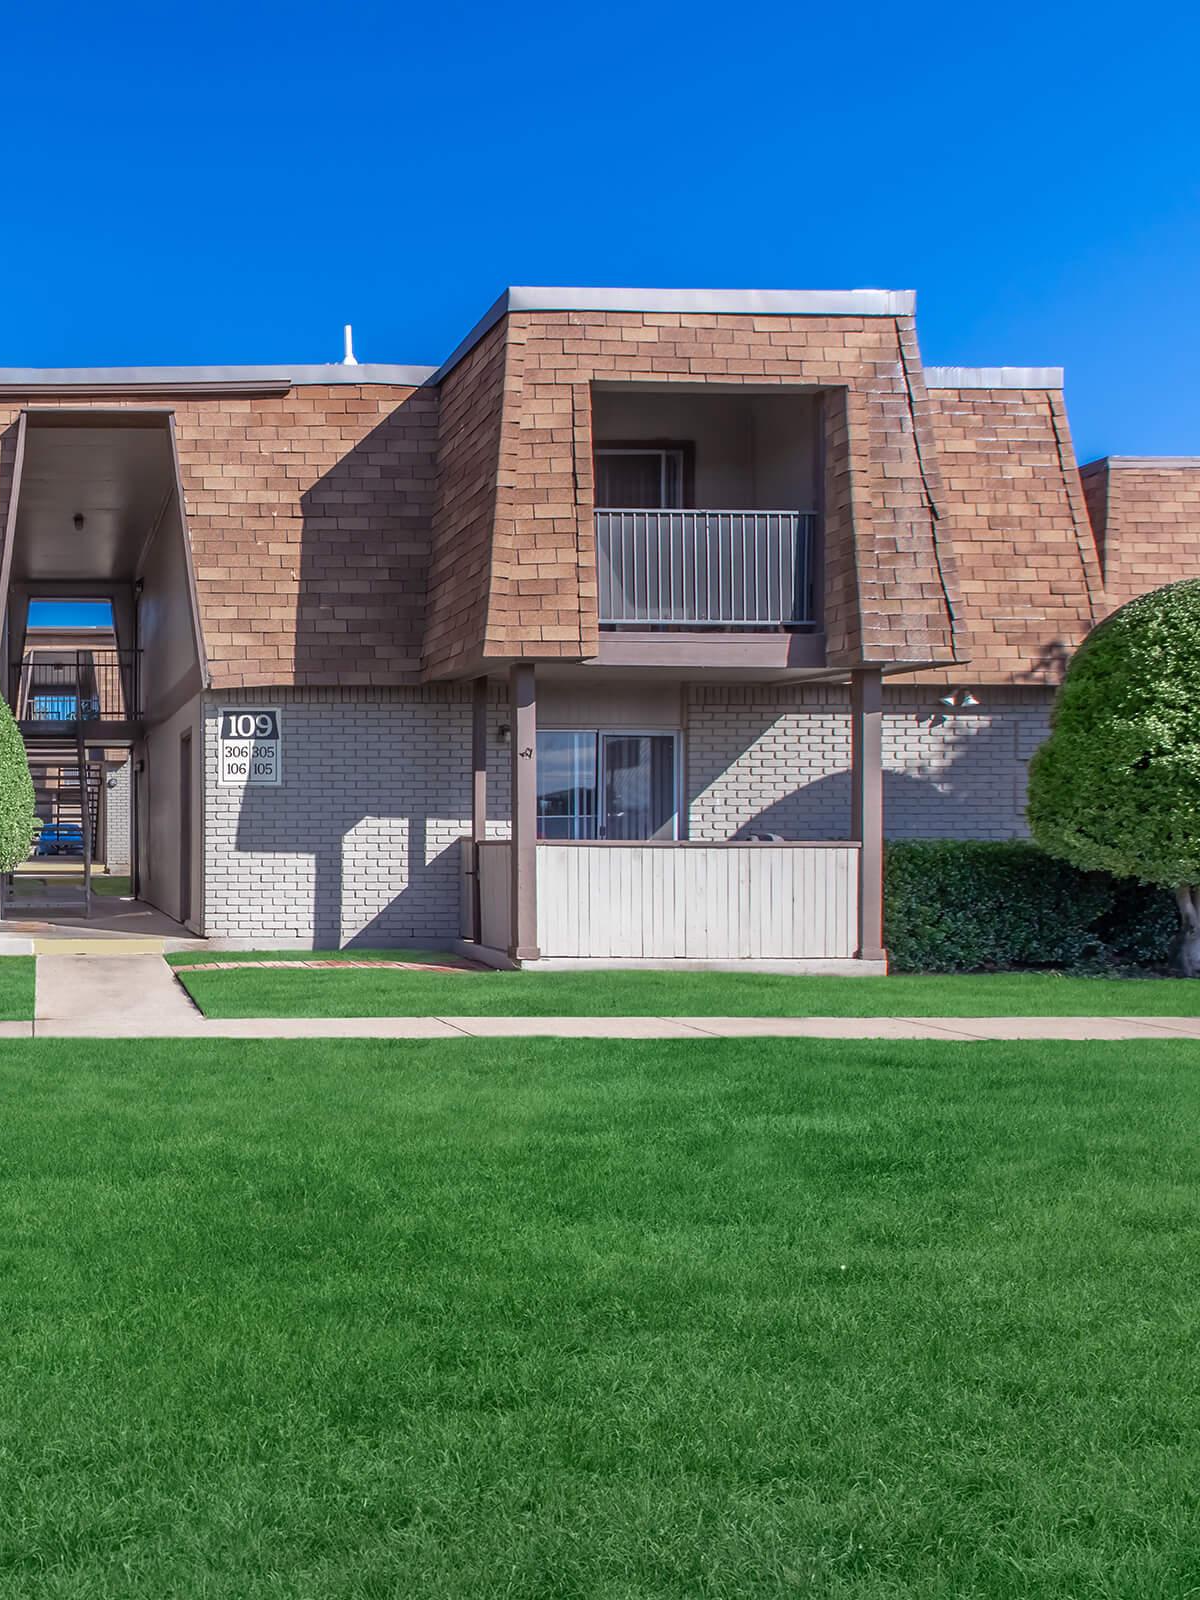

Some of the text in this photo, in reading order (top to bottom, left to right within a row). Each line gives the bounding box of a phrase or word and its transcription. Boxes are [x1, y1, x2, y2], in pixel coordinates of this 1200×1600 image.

[229, 714, 273, 737] 109
[225, 746, 248, 758] 306
[252, 746, 275, 758] 305
[227, 763, 247, 775] 106
[254, 763, 273, 775] 105
